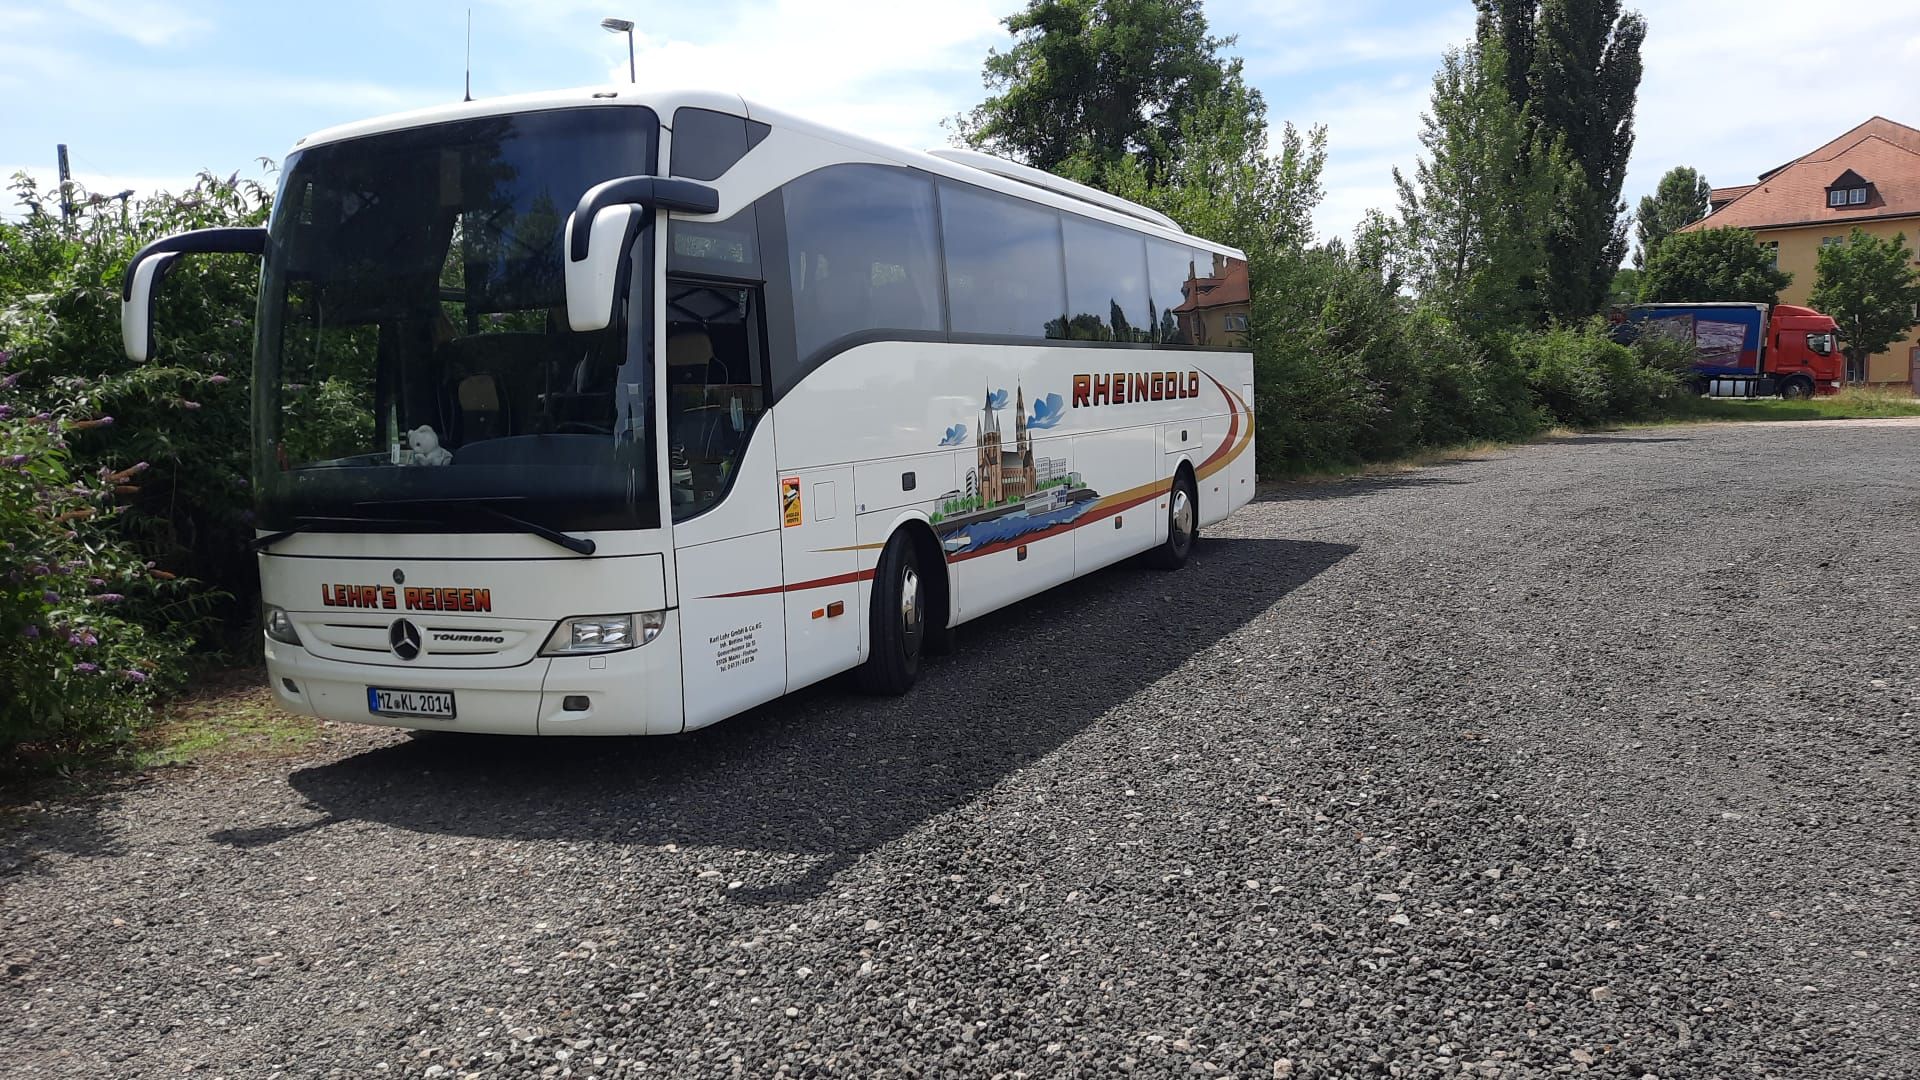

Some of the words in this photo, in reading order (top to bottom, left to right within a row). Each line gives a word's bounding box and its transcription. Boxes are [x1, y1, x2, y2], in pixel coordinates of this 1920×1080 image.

[1072, 371, 1200, 409] RHEINGOLD
[321, 583, 397, 610] LEHR'S
[404, 587, 492, 613] REISEN
[432, 633, 505, 644] TOURISMO
[709, 634, 719, 644] Karl
[730, 627, 744, 637] GmbH
[377, 692, 393, 710] MZ
[400, 694, 417, 711] KL
[419, 695, 451, 713] 2014
